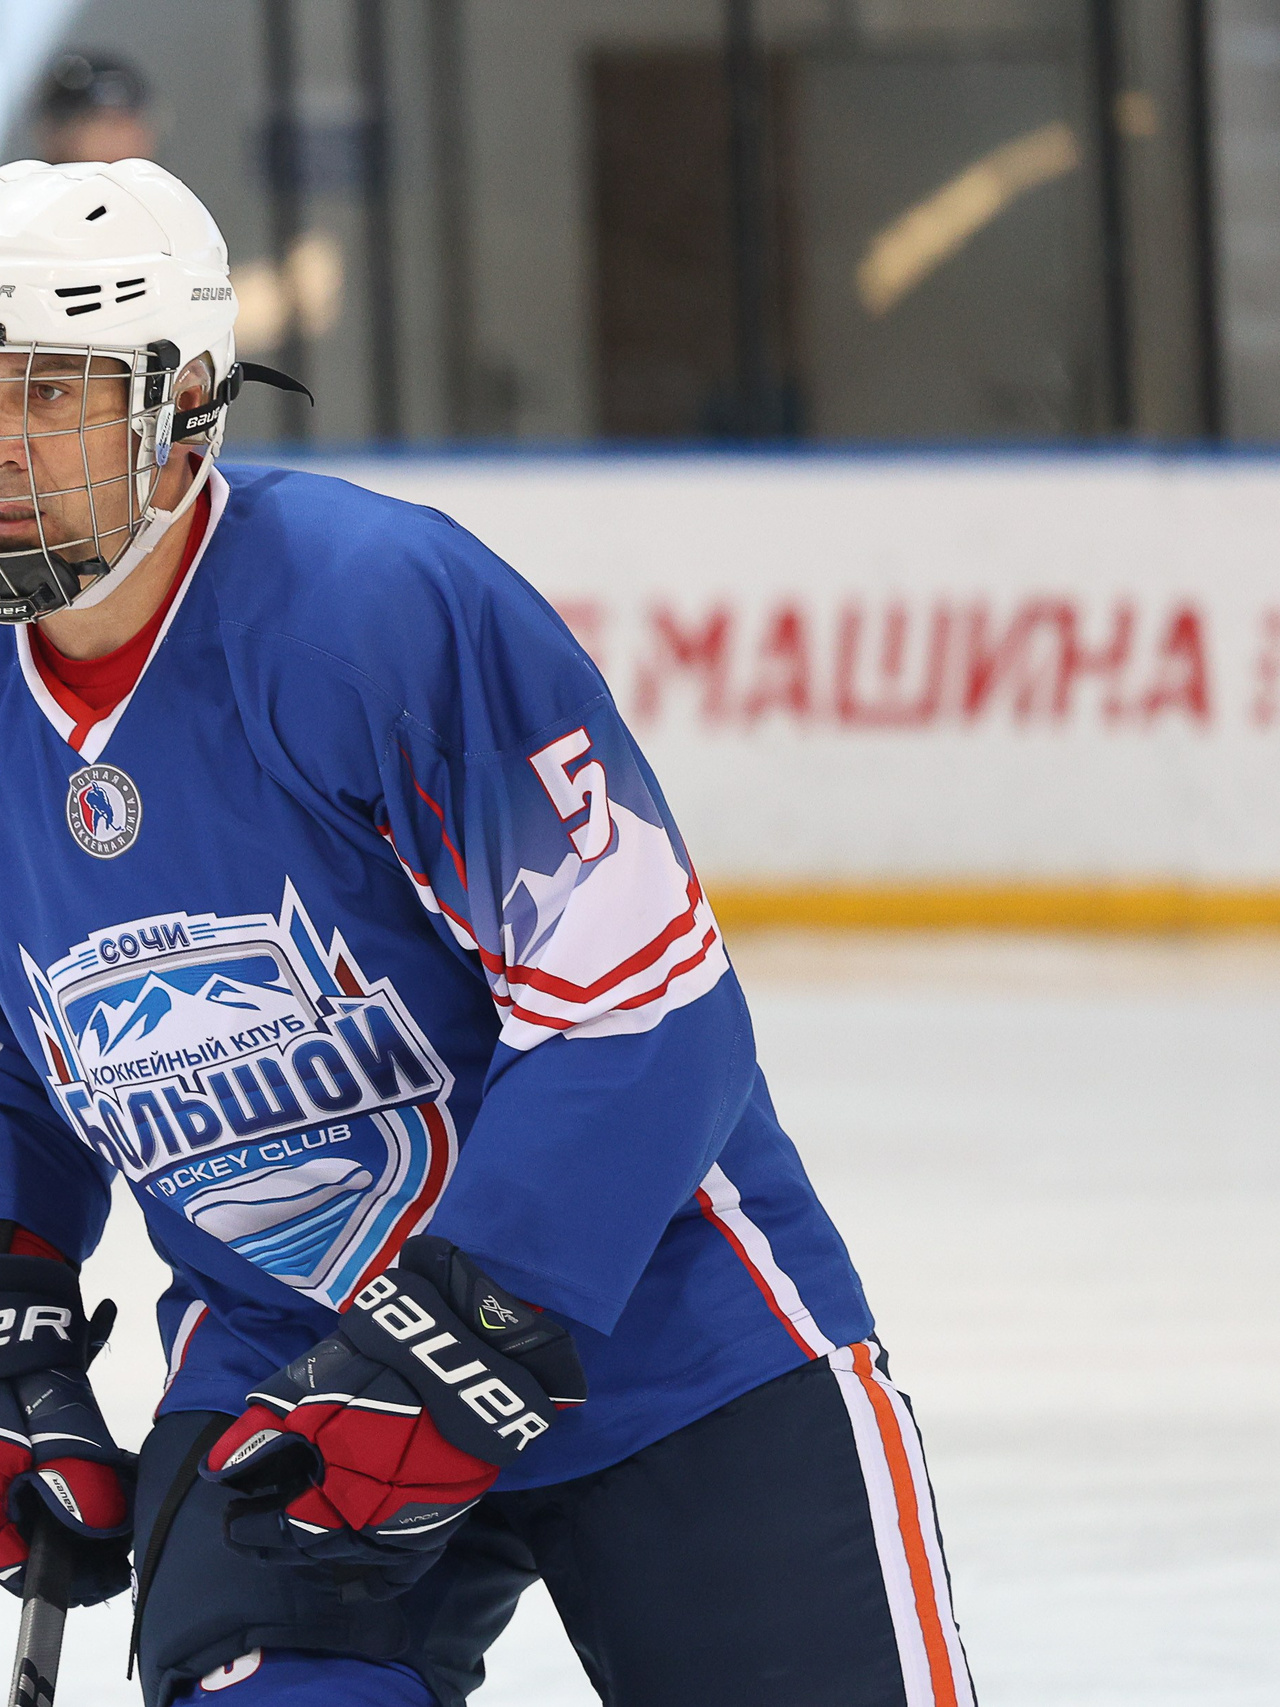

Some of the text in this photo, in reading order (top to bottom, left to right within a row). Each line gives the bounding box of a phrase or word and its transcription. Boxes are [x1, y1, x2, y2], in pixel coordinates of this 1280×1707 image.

[190, 287, 232, 301] BAUER
[186, 406, 221, 429] BAU
[633, 598, 1212, 728] МАШИНА
[528, 726, 614, 863] 5
[99, 921, 190, 964] СОЧИ
[64, 1002, 436, 1170] БОЛЬШОЙ
[90, 1013, 306, 1086] ХОККЕЙНЫЙ КЛУБ
[258, 1123, 352, 1162] CLUB
[353, 1275, 550, 1452] BAUER
